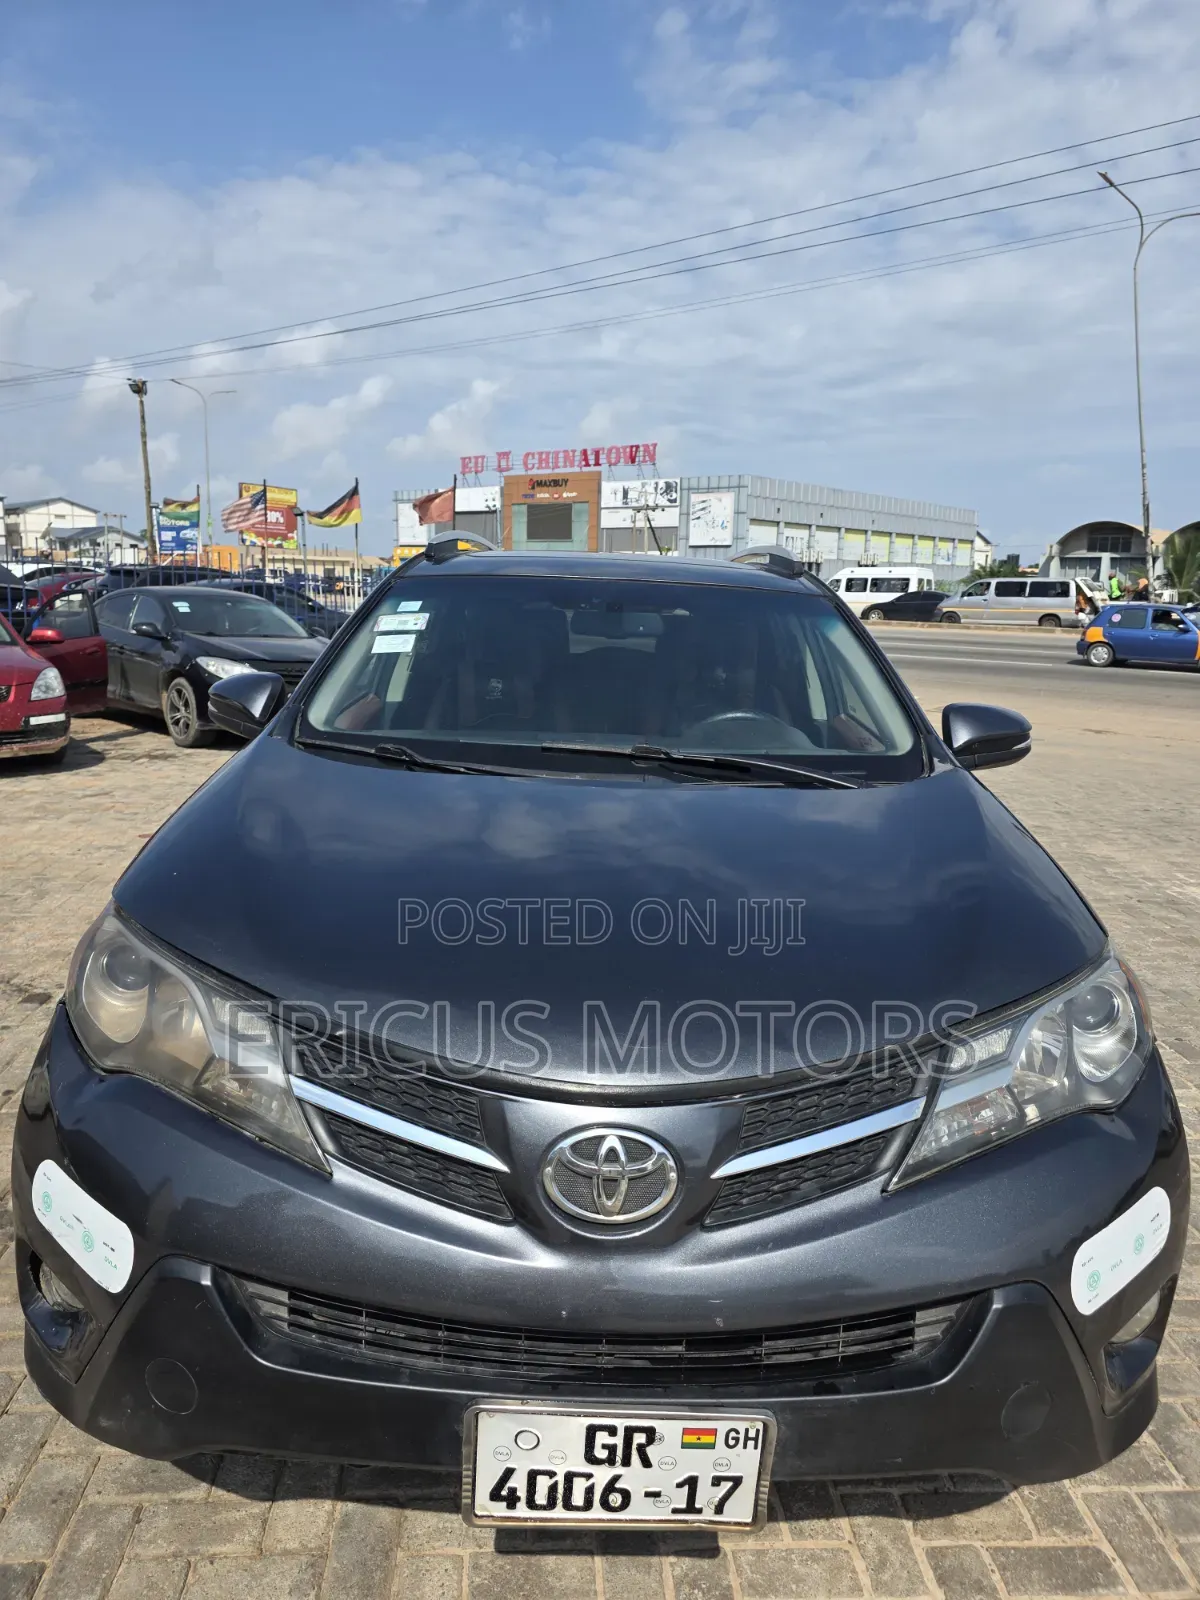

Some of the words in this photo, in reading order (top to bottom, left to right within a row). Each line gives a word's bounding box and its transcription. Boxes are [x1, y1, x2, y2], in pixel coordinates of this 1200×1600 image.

[523, 443, 658, 471] CHINATOWN
[536, 479, 568, 487] MAXBUY
[583, 1424, 657, 1469] GR
[724, 1427, 760, 1450] GH
